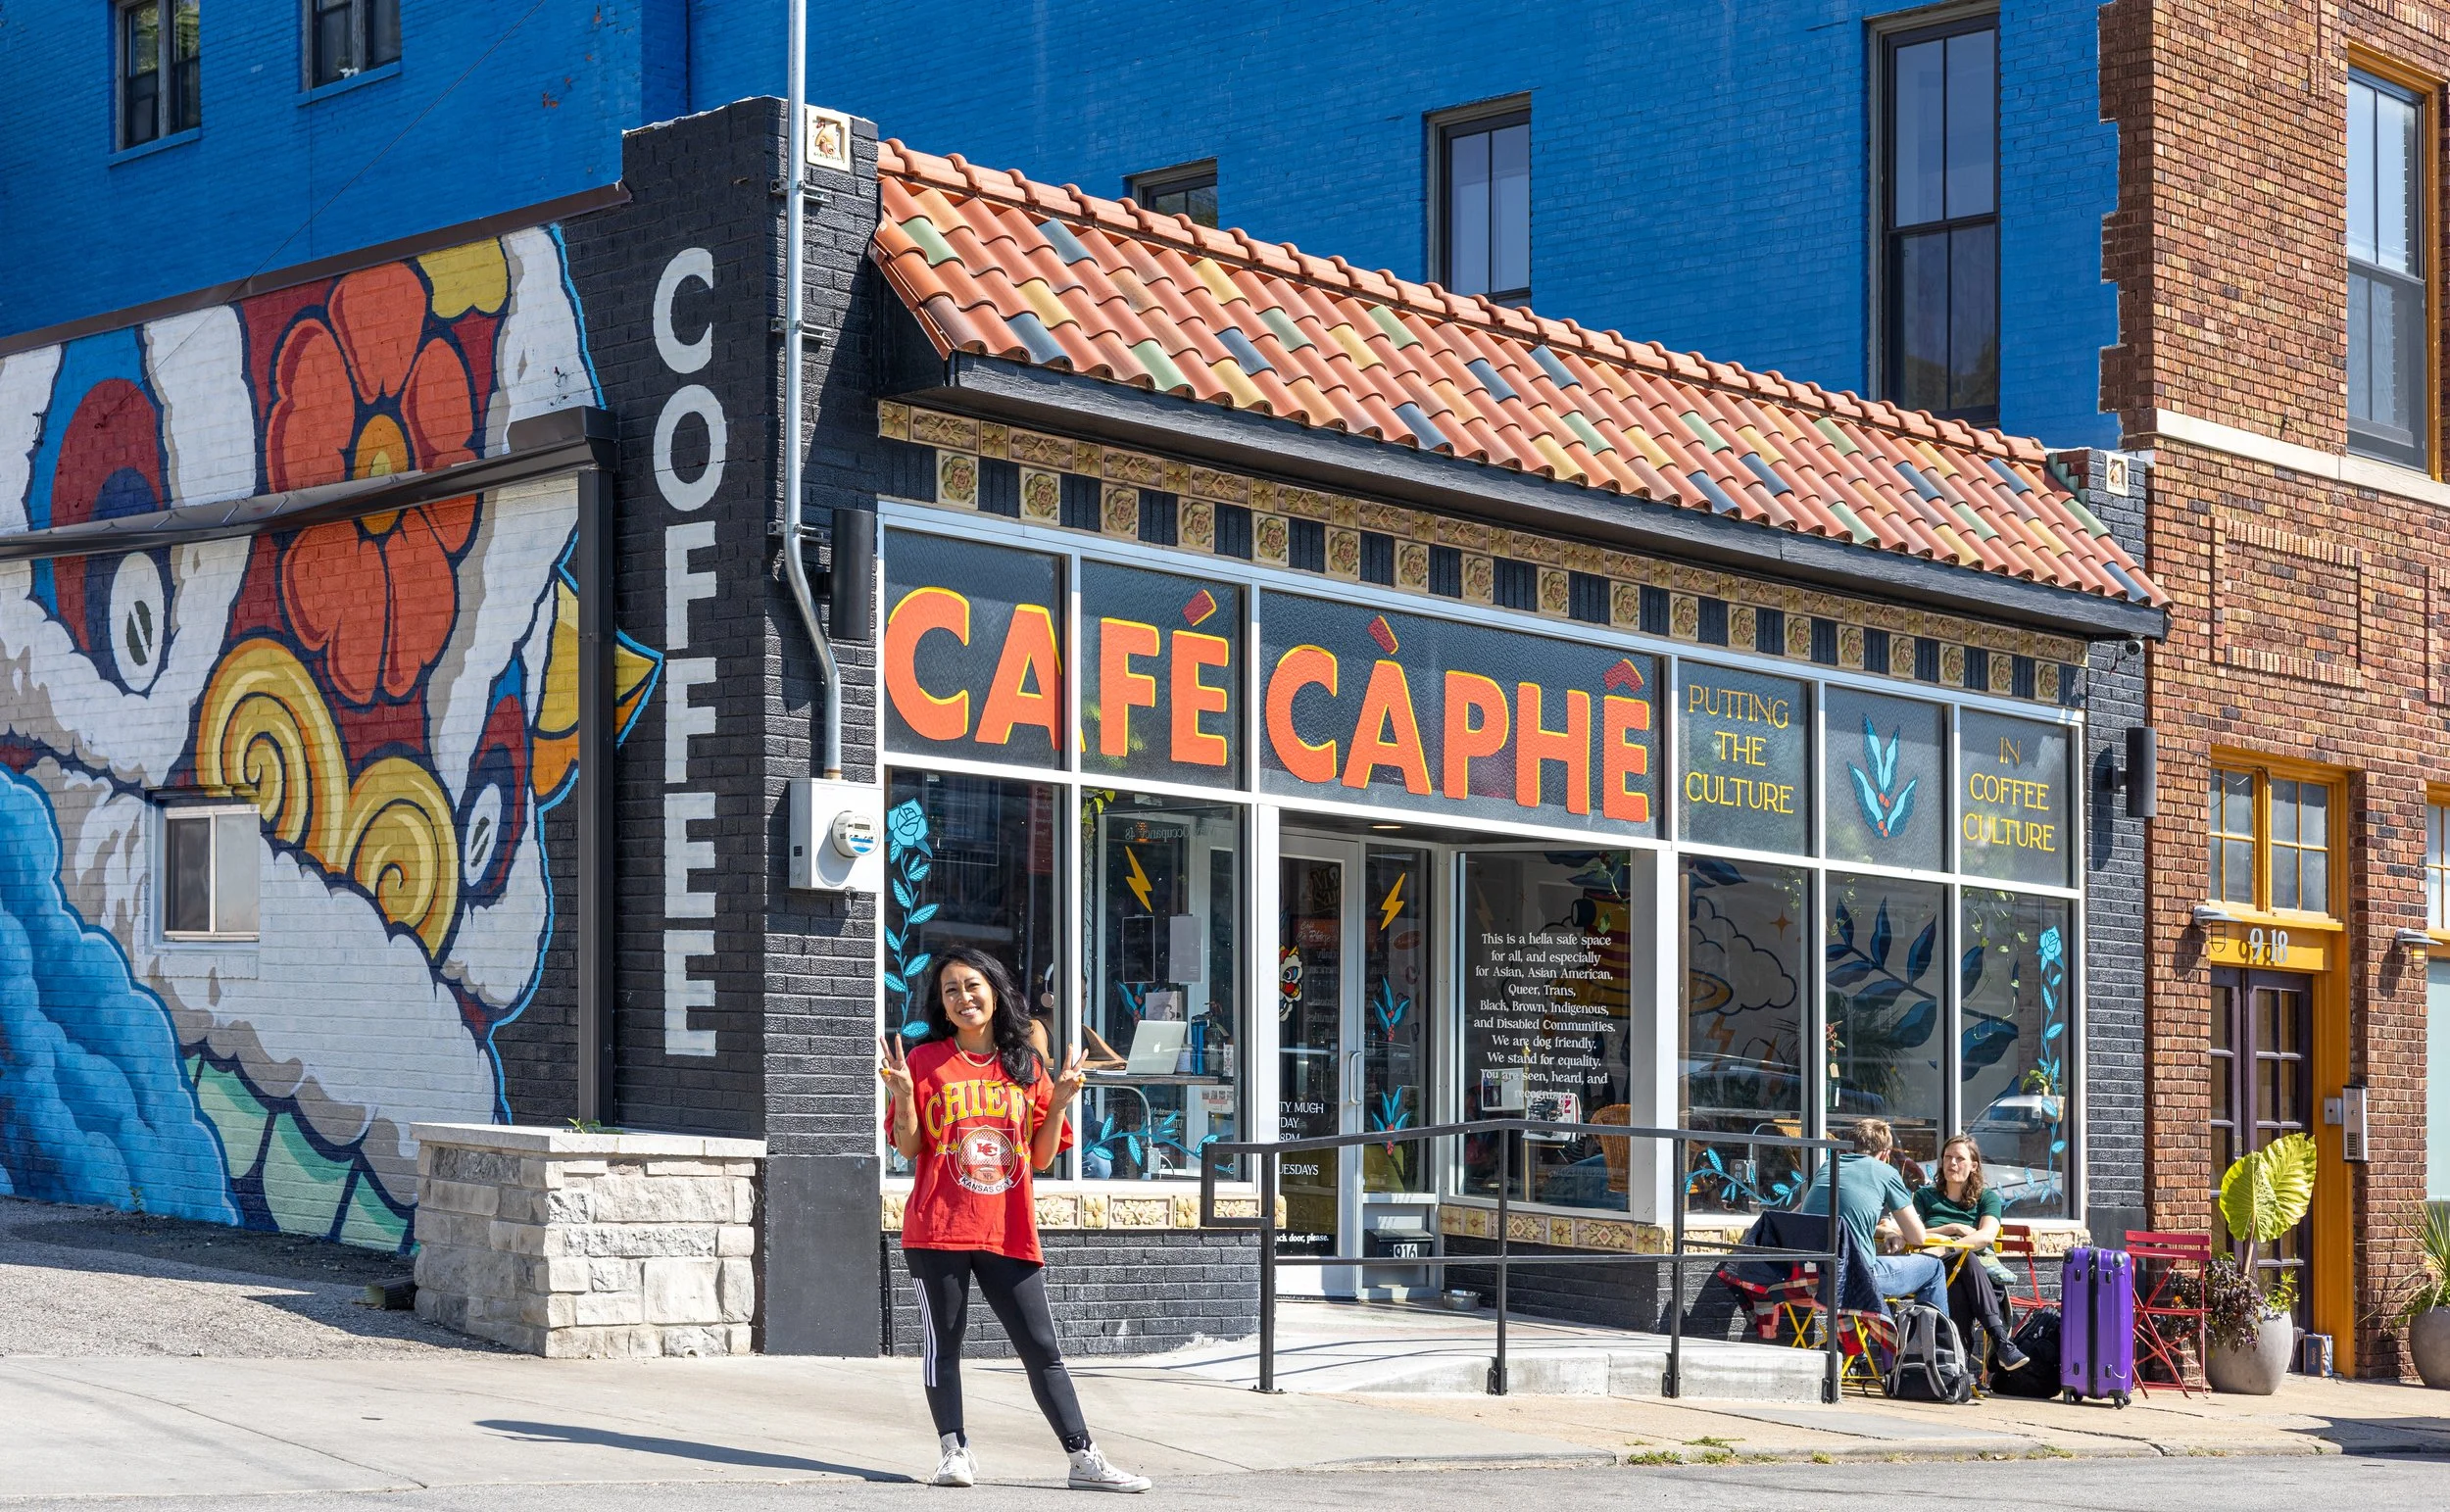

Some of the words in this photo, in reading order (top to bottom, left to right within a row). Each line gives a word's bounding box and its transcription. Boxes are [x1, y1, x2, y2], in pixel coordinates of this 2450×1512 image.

[653, 248, 727, 1056] COFFEE
[884, 586, 1229, 766] CAFÉ
[1689, 684, 1788, 729] PUTTING
[1714, 731, 1767, 766] THE
[1999, 737, 2021, 765] IN
[1685, 771, 1794, 814] CULTURE
[1970, 772, 2049, 810] COFFEE
[1963, 812, 2055, 852] CULTURE
[1481, 933, 1503, 945] This
[1506, 933, 1516, 944] is
[1519, 936, 1526, 945] a
[1529, 932, 1553, 945] hella
[1556, 933, 1578, 946] safe
[1581, 935, 1611, 949] space
[1491, 951, 1505, 961] for
[1508, 951, 1523, 963] all,
[1526, 951, 1545, 962] and
[1549, 951, 1601, 967] especially
[1475, 965, 1490, 977] for
[1493, 966, 1525, 979] Asian,
[1528, 967, 1557, 979] Asian
[1560, 968, 1613, 981] American,
[1508, 984, 1541, 997] Queer,
[1544, 985, 1576, 997] Trans,
[1480, 1000, 1509, 1012] Black,
[1512, 1000, 1547, 1013] Brown,
[1550, 1001, 1609, 1016] Indigenous,
[1473, 1017, 1494, 1028] and
[1496, 1018, 1540, 1030] Disabled
[1543, 1019, 1616, 1032] Communities.
[1492, 1035, 1510, 1046] We
[1512, 1037, 1530, 1047] are
[1533, 1036, 1551, 1049] dog
[1554, 1037, 1596, 1052] friendly.
[1487, 1052, 1505, 1063] We
[1507, 1052, 1537, 1064] stand
[1541, 1053, 1555, 1065] for
[1557, 1055, 1601, 1070] equality.
[1481, 1069, 1499, 1079] You
[1522, 1072, 1549, 1083] seen,
[1551, 1071, 1584, 1085] heard,
[1587, 1072, 1608, 1085] and
[1514, 1088, 1570, 1102] recogni
[1295, 1102, 1324, 1114] MUCH
[1279, 1164, 1319, 1176] UESDAYS
[961, 1177, 995, 1194] KANSAS
[1289, 1233, 1305, 1243] door,
[1306, 1233, 1329, 1244] please.
[1395, 1244, 1416, 1258] 916
